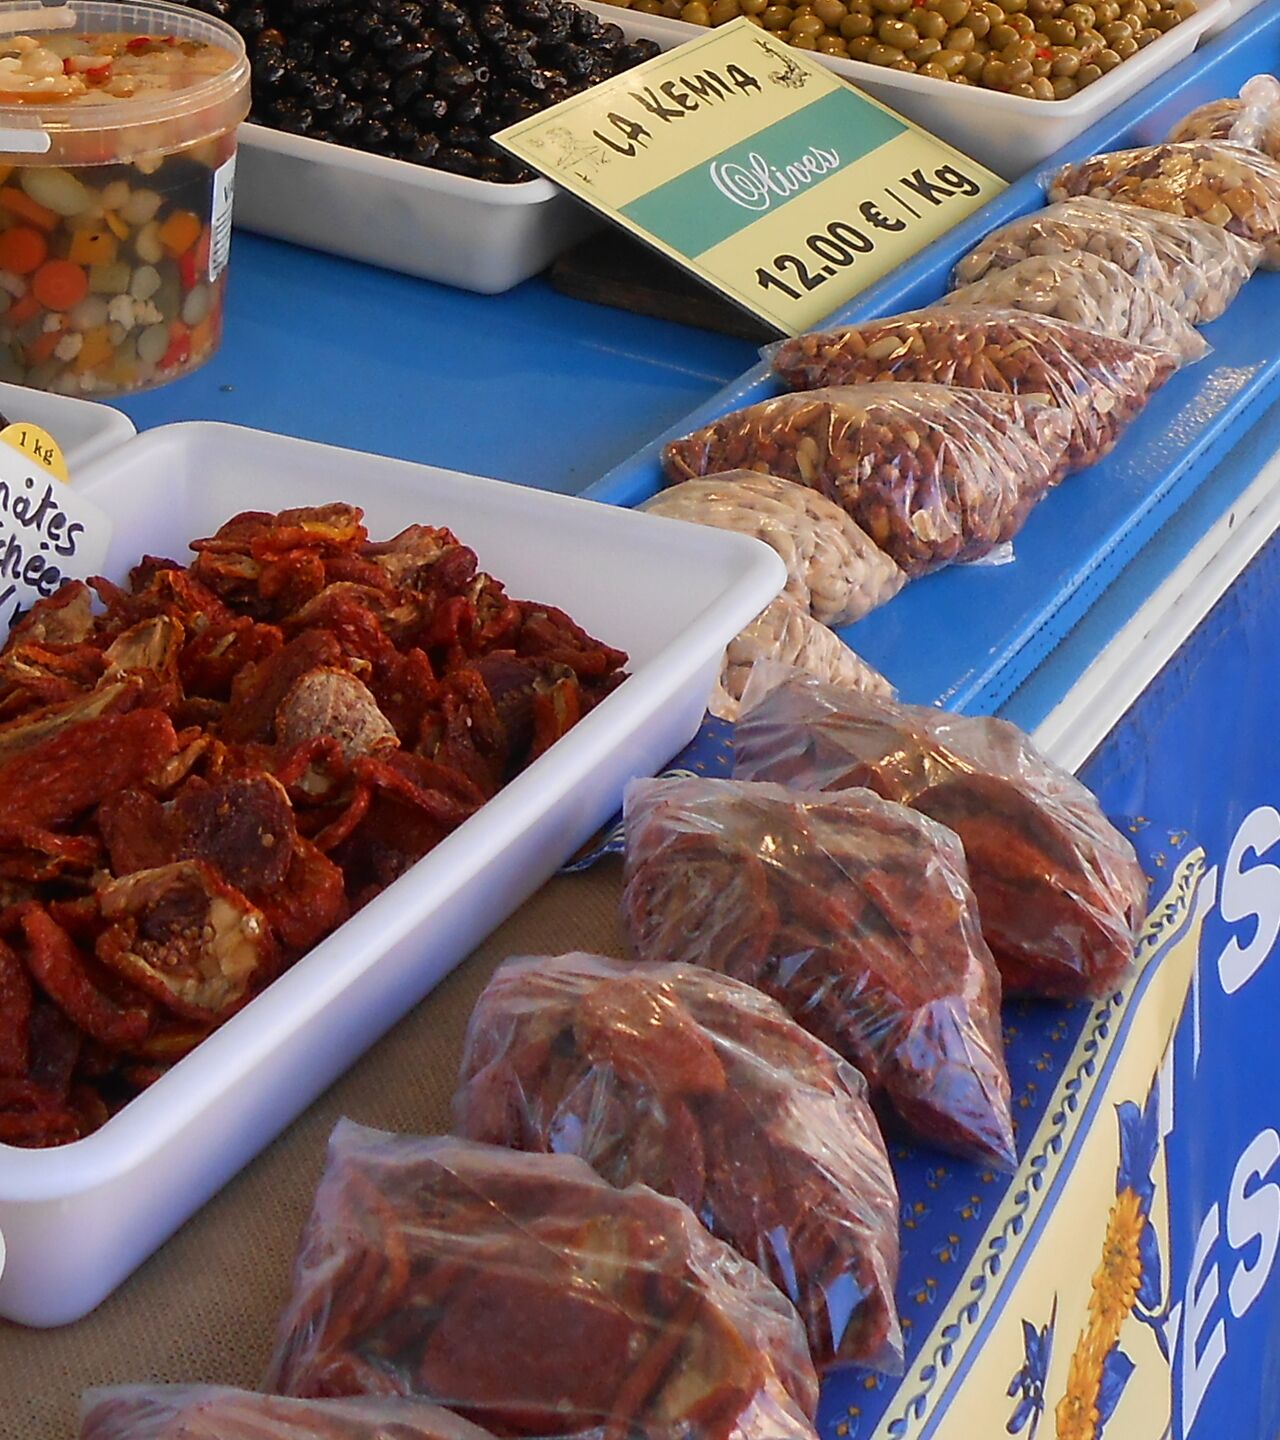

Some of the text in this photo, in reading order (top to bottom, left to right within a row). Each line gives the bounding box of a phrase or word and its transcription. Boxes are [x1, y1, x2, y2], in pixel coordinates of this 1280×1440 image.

[592, 62, 762, 158] LA KEMIA
[709, 144, 841, 212] Olives
[754, 218, 876, 301] 12.00
[897, 163, 982, 208] Kg
[18, 431, 54, 467] 1 kg
